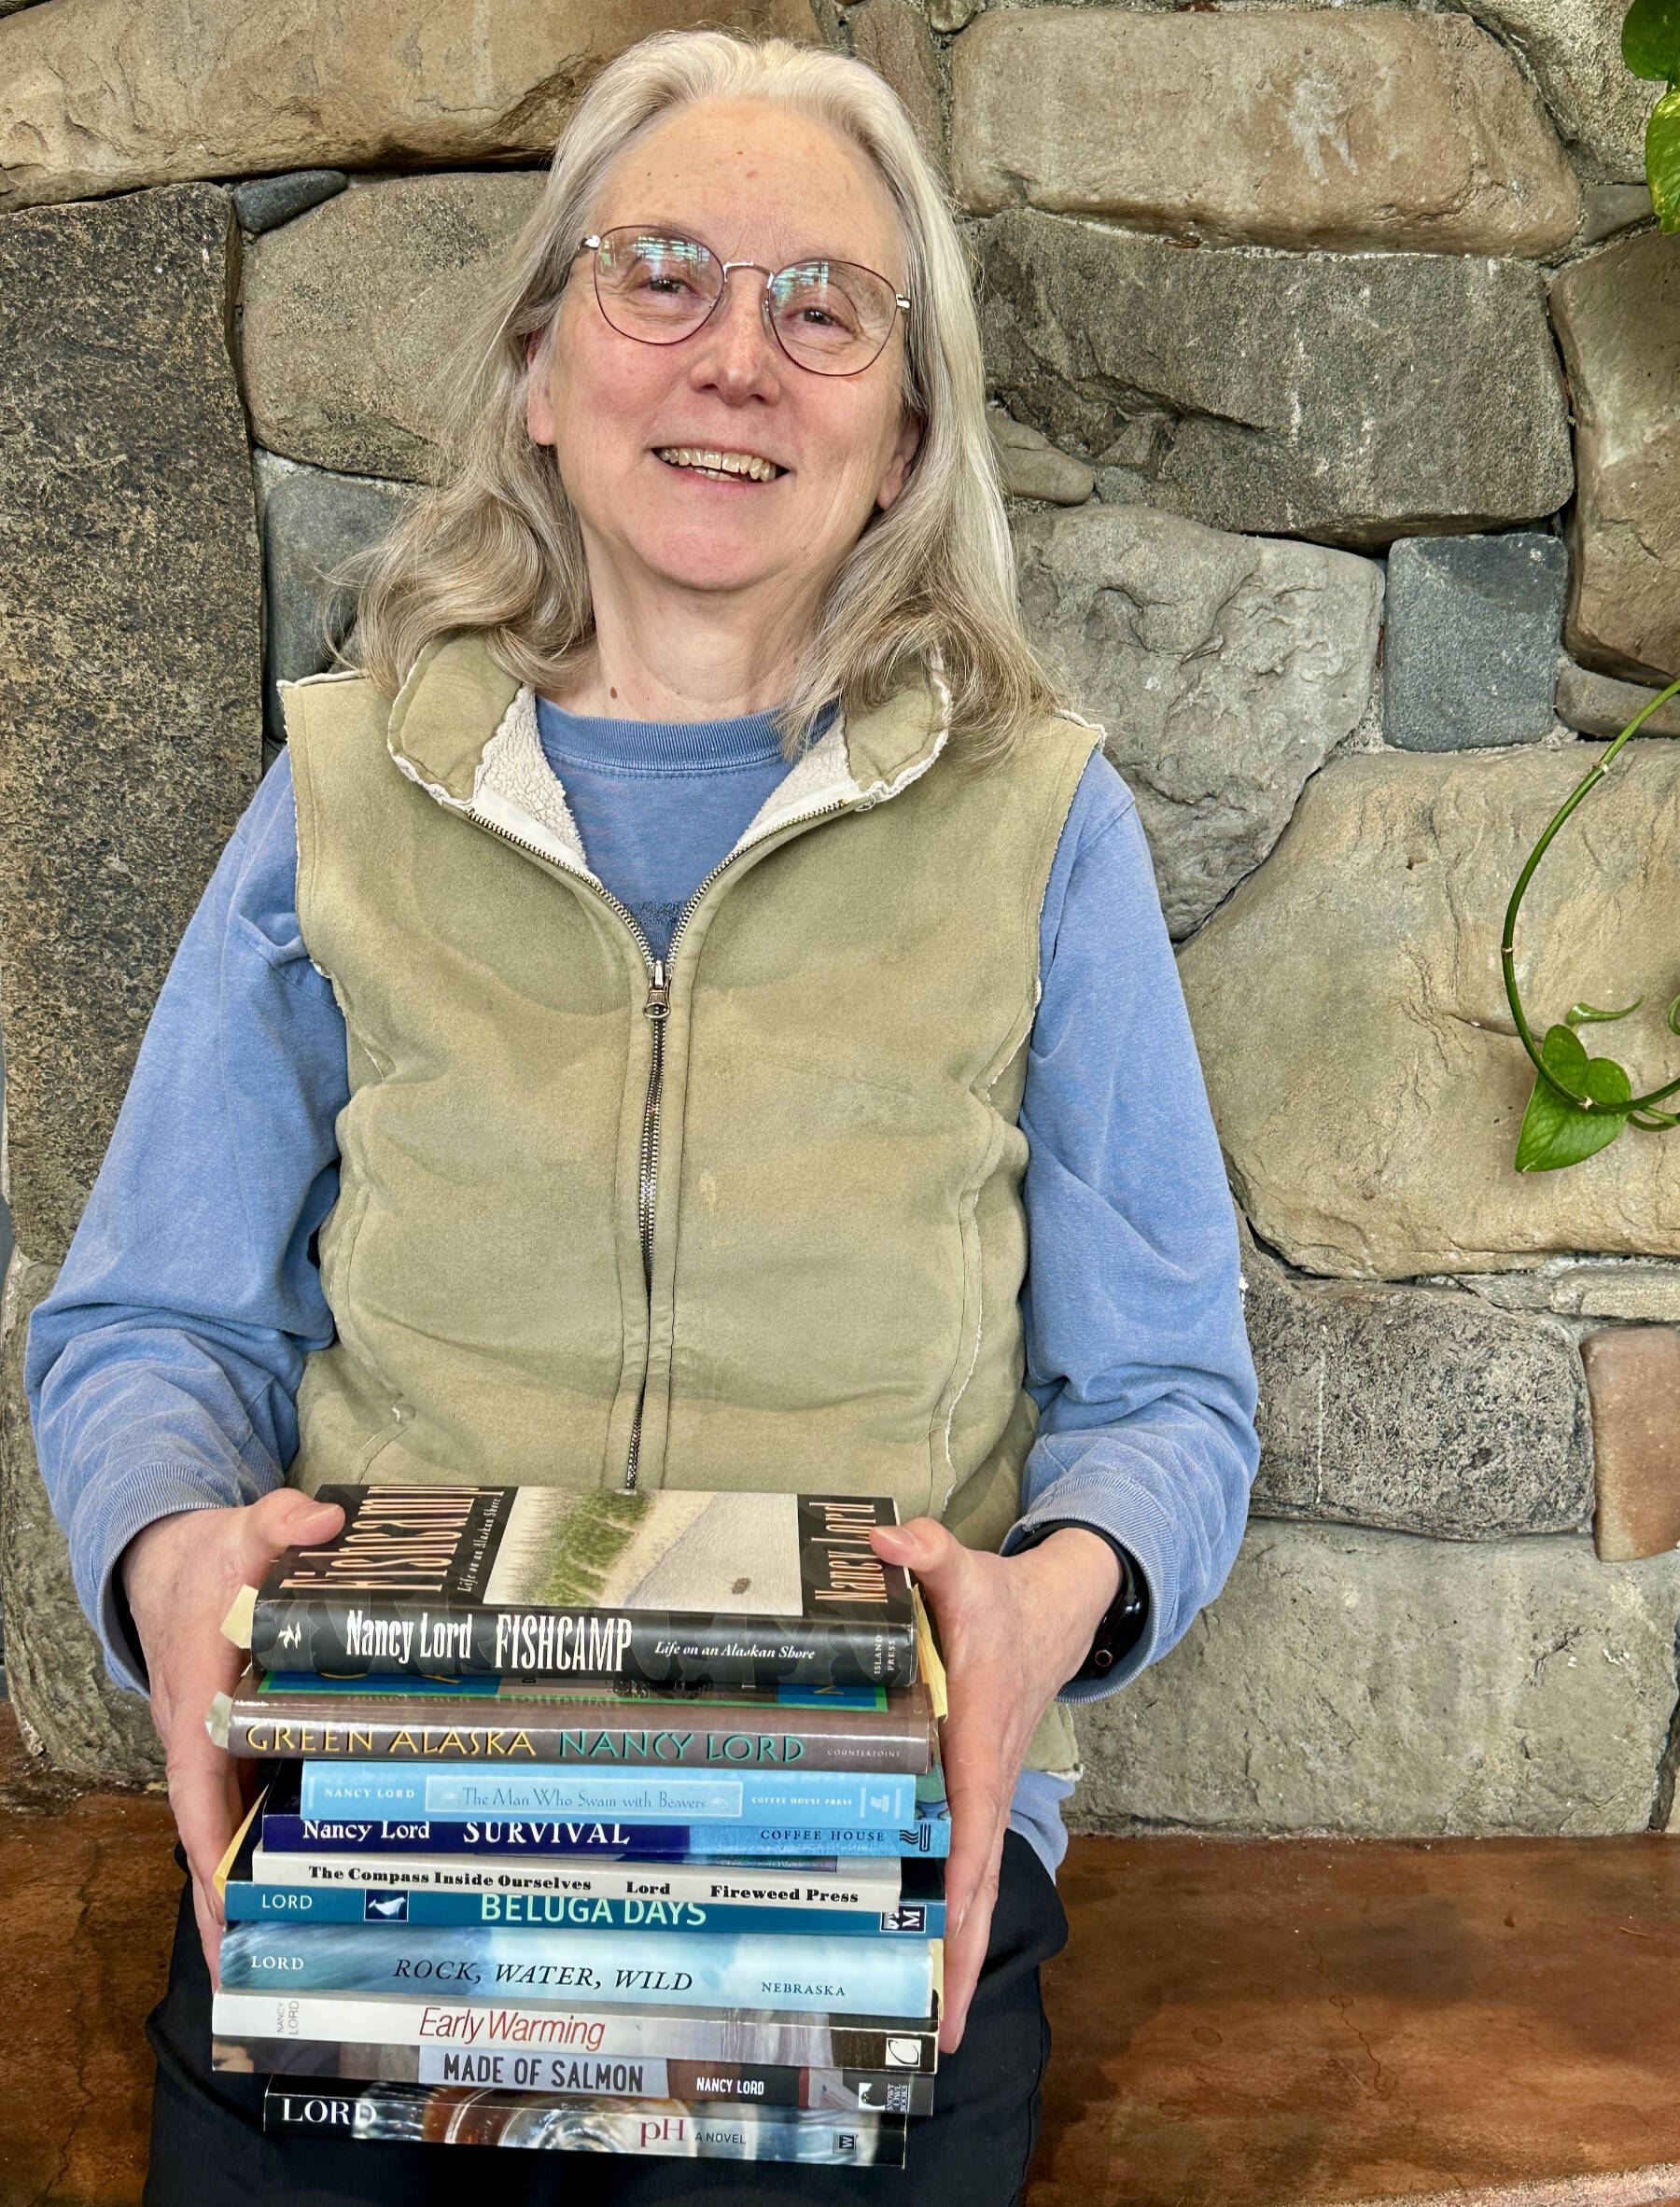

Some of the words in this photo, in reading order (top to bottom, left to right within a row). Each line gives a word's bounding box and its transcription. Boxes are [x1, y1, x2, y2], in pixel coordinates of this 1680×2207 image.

[809, 1502, 876, 1544] Lord
[457, 1573, 478, 1592] Life
[814, 1550, 888, 1603] Nancy
[346, 1609, 414, 1665] Nancy
[420, 1612, 473, 1659] Lord
[494, 1613, 633, 1672] FISHCAMP
[654, 1641, 679, 1655] Life
[683, 1644, 698, 1655] on
[702, 1646, 719, 1656] an
[721, 1642, 776, 1658] Alaskan
[778, 1644, 816, 1660] Shore
[874, 1634, 883, 1675] ISLAND
[887, 1640, 896, 1671] PRESS
[246, 1725, 373, 1752] GREEN
[388, 1729, 537, 1756] ALASKA
[560, 1730, 696, 1761] NANCY
[707, 1733, 805, 1764] LORD
[827, 1747, 902, 1759] COUNTERPOINT
[324, 1787, 372, 1798] NANCY
[377, 1789, 415, 1798] LORD
[463, 1787, 489, 1807] The
[493, 1788, 529, 1807] Man
[533, 1788, 572, 1808] Who
[577, 1790, 616, 1809] Swam
[623, 1791, 652, 1809] with
[659, 1791, 706, 1809] Beavers
[751, 1796, 787, 1805] COFFEE
[791, 1797, 821, 1806] HOUSE
[825, 1798, 853, 1807] PRESS
[302, 1821, 372, 1842] Nancy
[380, 1821, 430, 1840] Lord
[463, 1821, 631, 1845] SURVIVAL
[760, 1829, 822, 1841] COFFEE
[831, 1830, 886, 1842] HOUSE
[309, 1865, 344, 1879] The
[348, 1867, 429, 1886] Compass
[434, 1871, 494, 1887] Inside
[497, 1874, 592, 1892] Ourselves
[626, 1881, 671, 1895] Lord
[710, 1884, 800, 1902] Fireweed
[806, 1889, 860, 1904] Press
[261, 1894, 313, 1910] LORD
[482, 1893, 614, 1923] BELUGA
[623, 1898, 707, 1926] DAYS
[251, 1955, 304, 1971] LORD
[392, 1958, 482, 1984] ROCK,
[495, 1963, 602, 1990] WATER,
[615, 1969, 693, 1991] WILD
[762, 1981, 846, 1997] NEBRASKA
[276, 2001, 285, 2032] NANCY
[288, 2000, 300, 2035] LORD
[419, 2006, 484, 2045] Early
[488, 2009, 606, 2052] Warming
[443, 2053, 504, 2084] MADE
[513, 2058, 541, 2086] OF
[552, 2059, 644, 2093] SALMON
[696, 2076, 734, 2094] NANCY
[736, 2079, 765, 2096] LORD
[281, 2098, 377, 2127] LORD
[640, 2118, 685, 2148] pH
[695, 2131, 705, 2142] A
[706, 2131, 746, 2145] NOVEL
